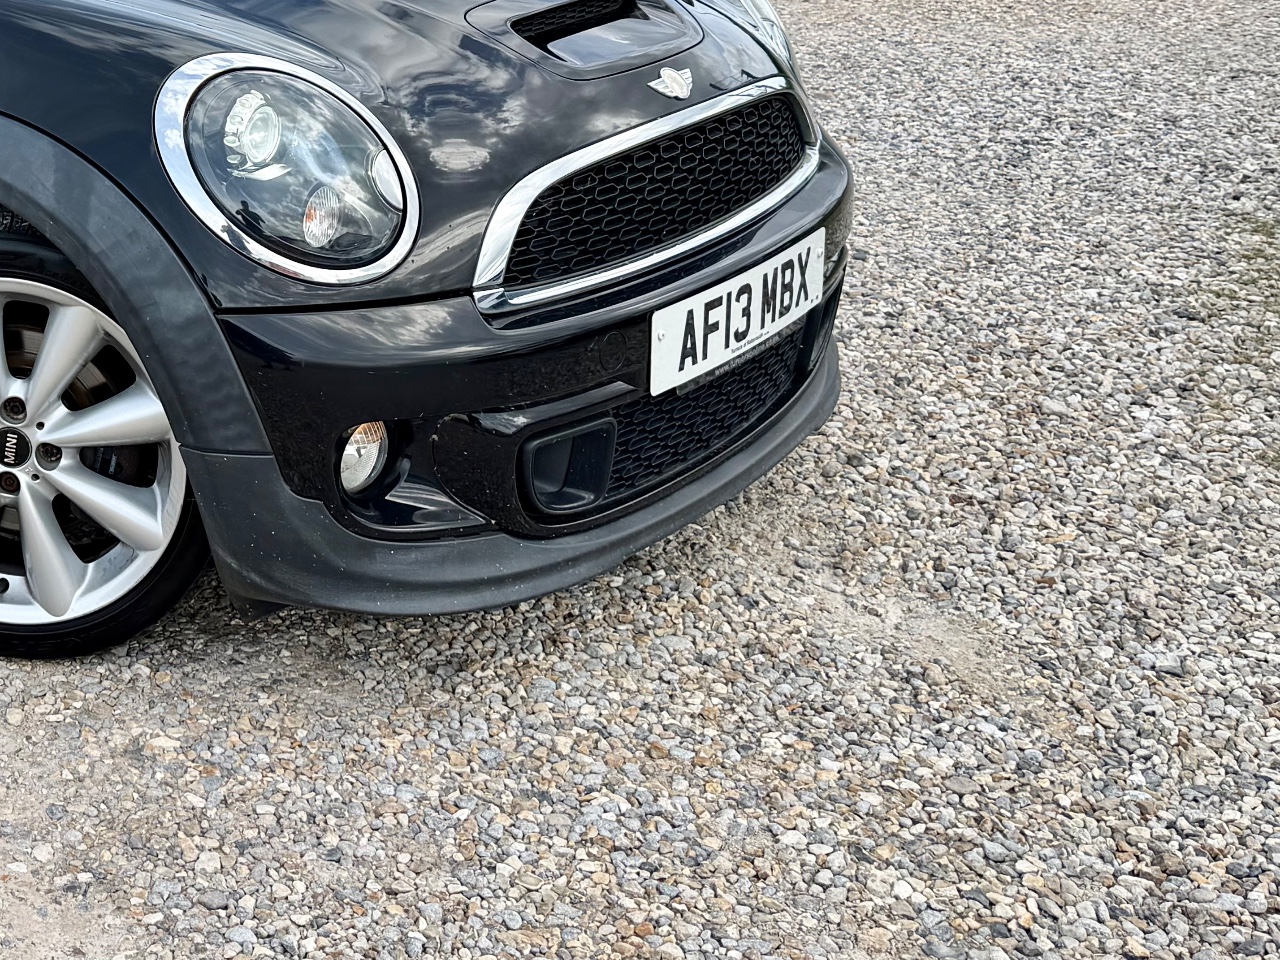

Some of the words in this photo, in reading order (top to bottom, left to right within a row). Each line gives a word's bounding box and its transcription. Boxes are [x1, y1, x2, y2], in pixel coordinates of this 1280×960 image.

[678, 282, 753, 373] AF13
[760, 246, 811, 331] MBX
[3, 433, 18, 464] MINI
